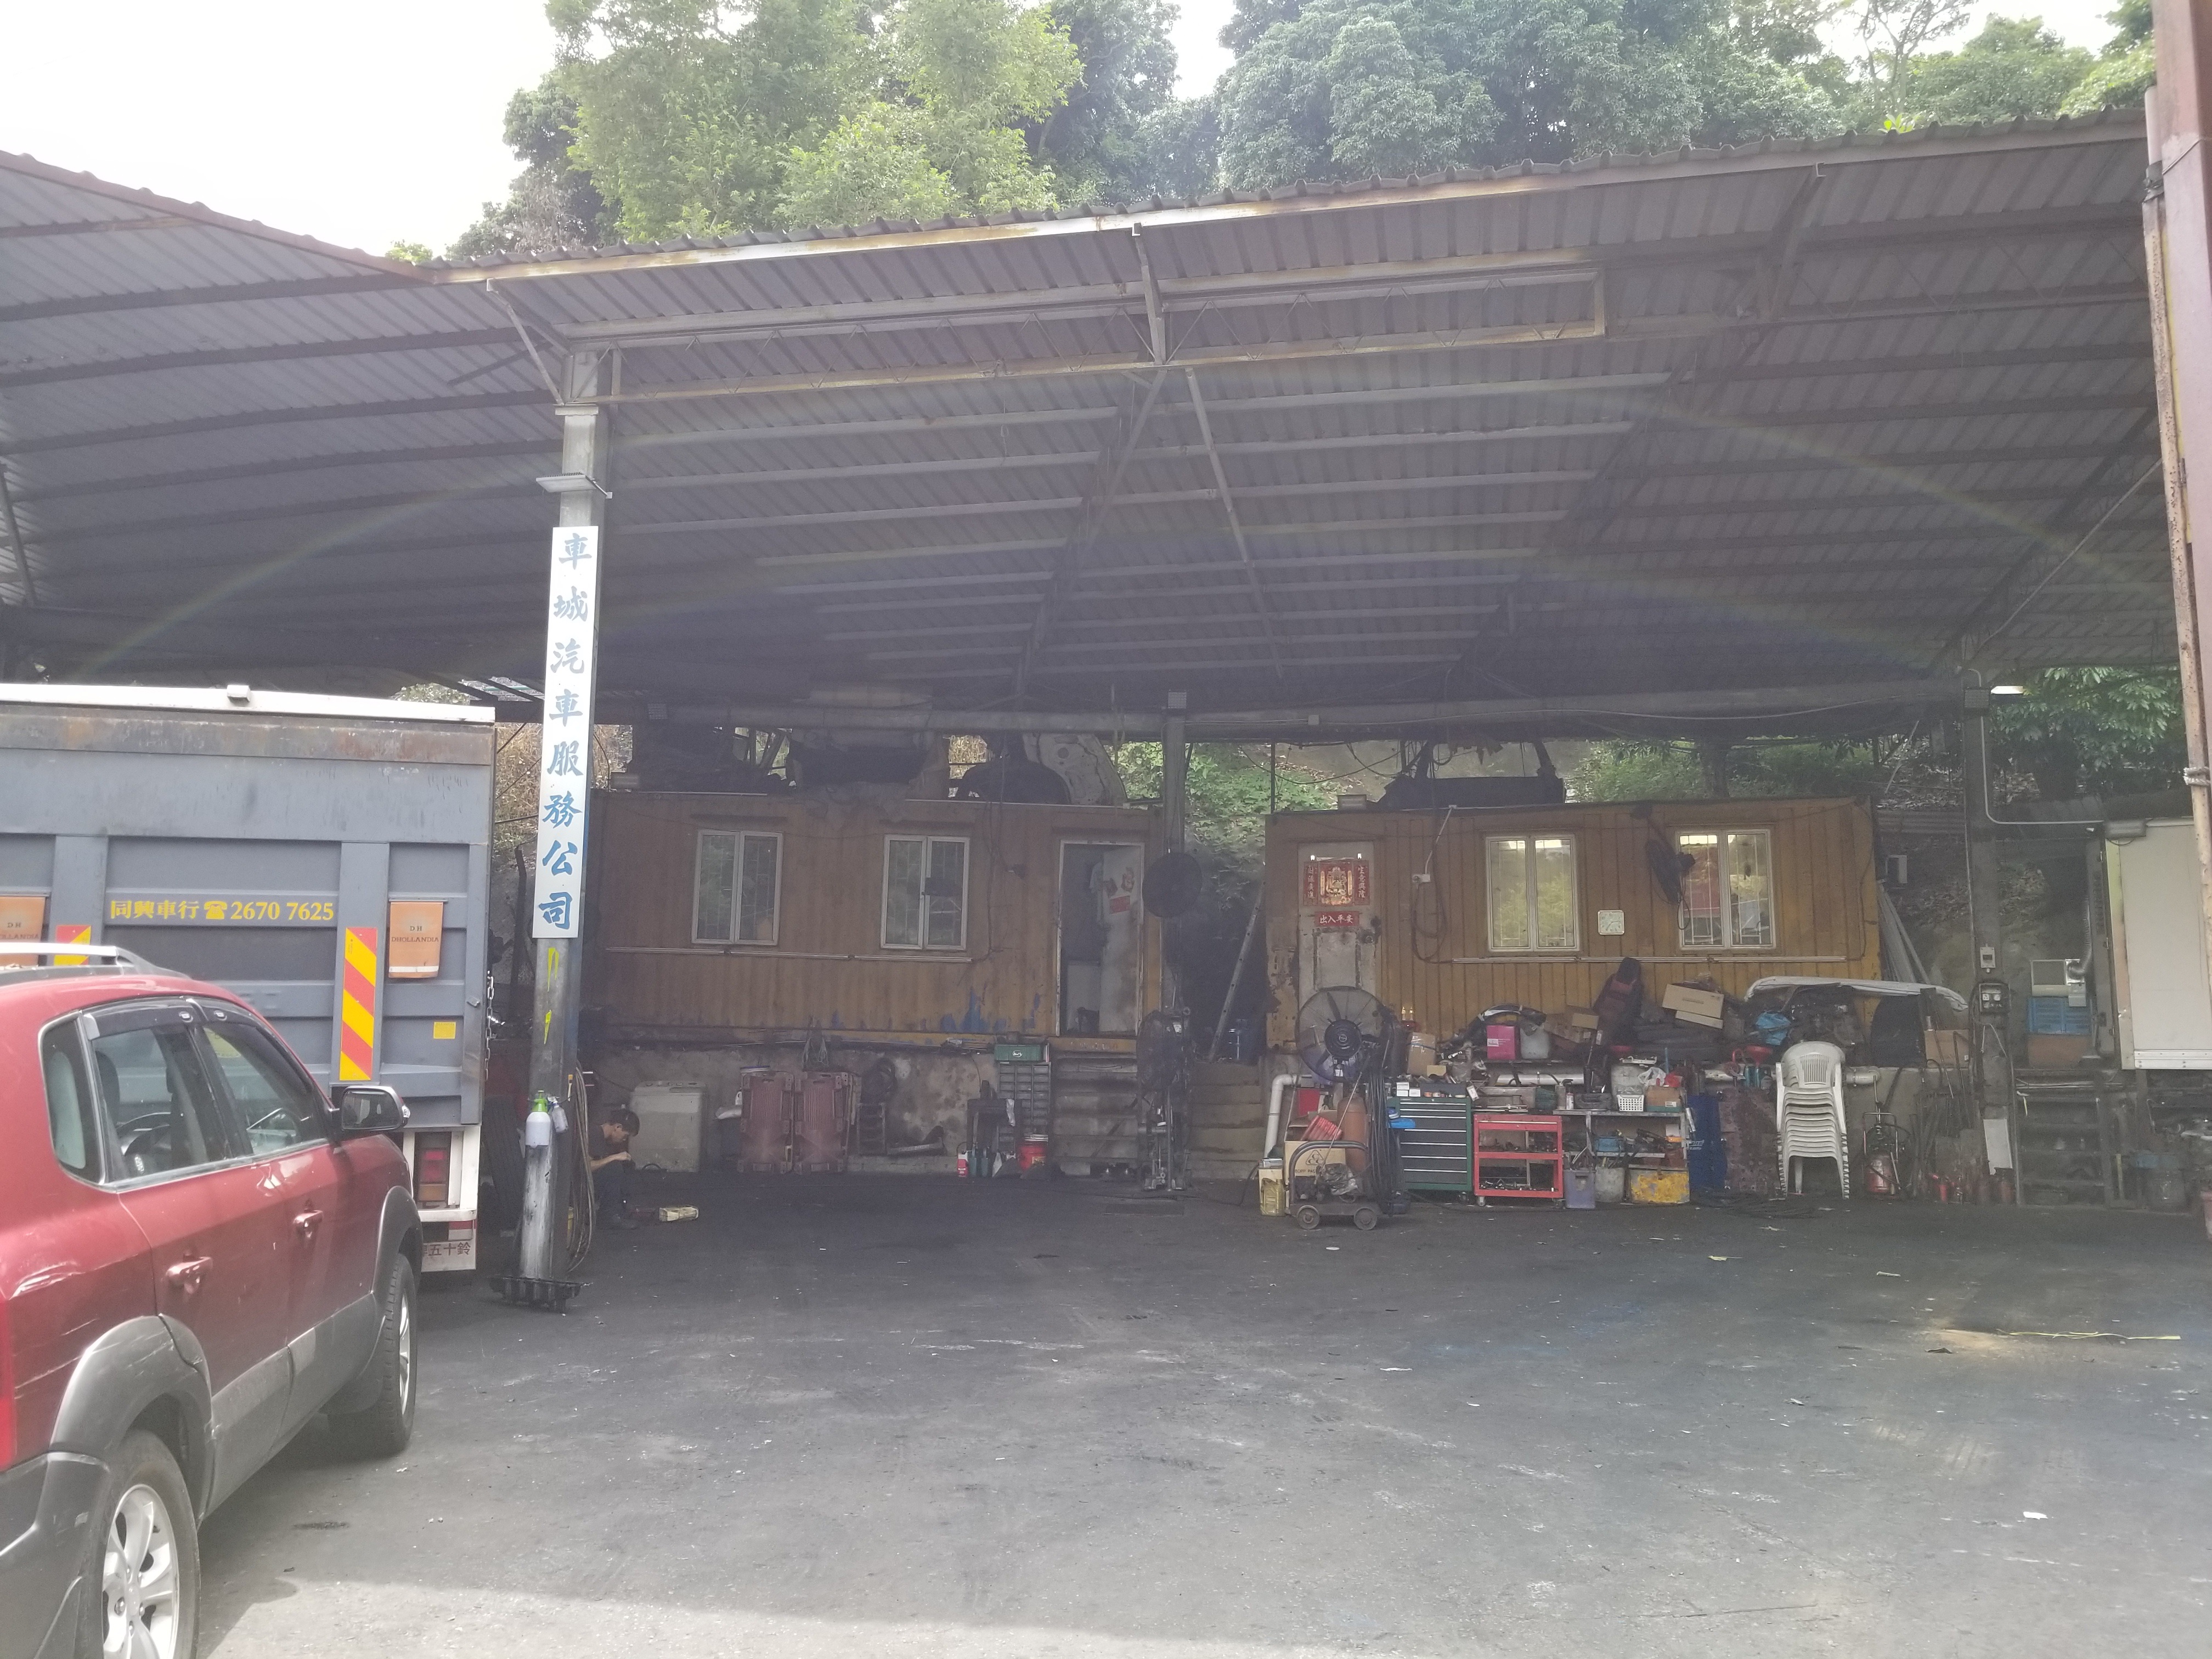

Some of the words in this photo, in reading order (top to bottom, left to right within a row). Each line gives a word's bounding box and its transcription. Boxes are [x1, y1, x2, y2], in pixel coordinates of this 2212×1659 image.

[538, 533, 592, 929] 車城汽車服務公司
[111, 900, 199, 919] 同興車行
[230, 901, 280, 919] 2670
[286, 902, 334, 921] 7625
[1319, 914, 1353, 924] 出入平安
